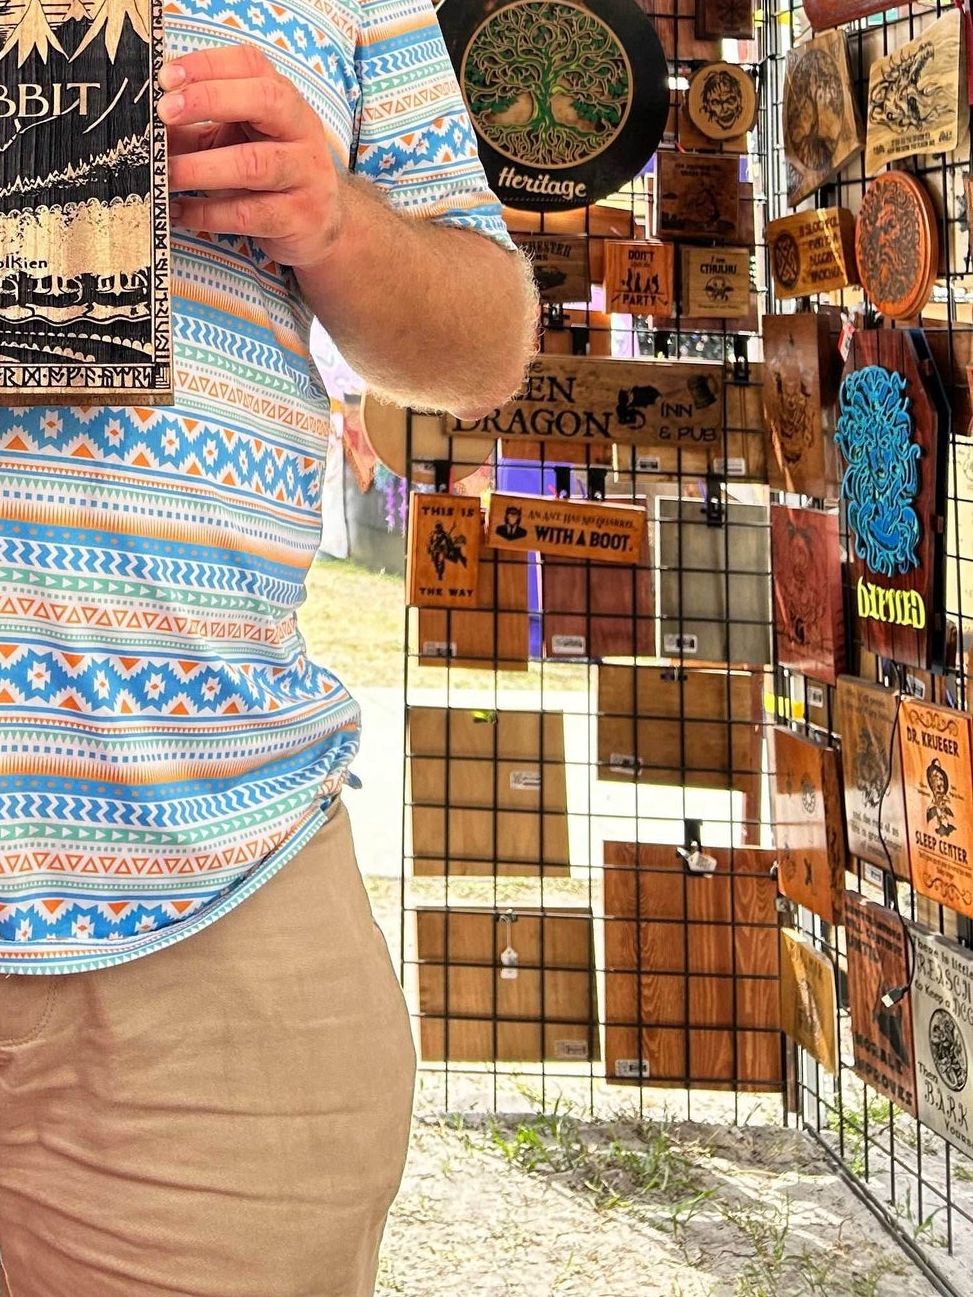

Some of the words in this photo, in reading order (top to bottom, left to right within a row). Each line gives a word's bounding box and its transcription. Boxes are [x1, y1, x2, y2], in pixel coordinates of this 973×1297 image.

[497, 165, 588, 201] Heritage
[628, 249, 655, 262] DON'T
[699, 263, 737, 275] CTHULHU
[622, 293, 657, 307] PARTY
[660, 402, 693, 419] INN
[452, 407, 613, 439] DRAGON
[658, 425, 671, 441] &
[677, 427, 718, 442] PUB
[421, 505, 455, 518] THIS
[461, 505, 475, 518] IS
[534, 525, 575, 546] WITH
[575, 531, 586, 547] A
[589, 532, 634, 553] BOOT.
[418, 586, 443, 598] THE
[448, 588, 474, 598] WAY
[906, 725, 920, 745] DR.
[921, 730, 961, 759] KRUEGER
[915, 830, 937, 851] SLEEP
[938, 840, 969, 865] CENTER
